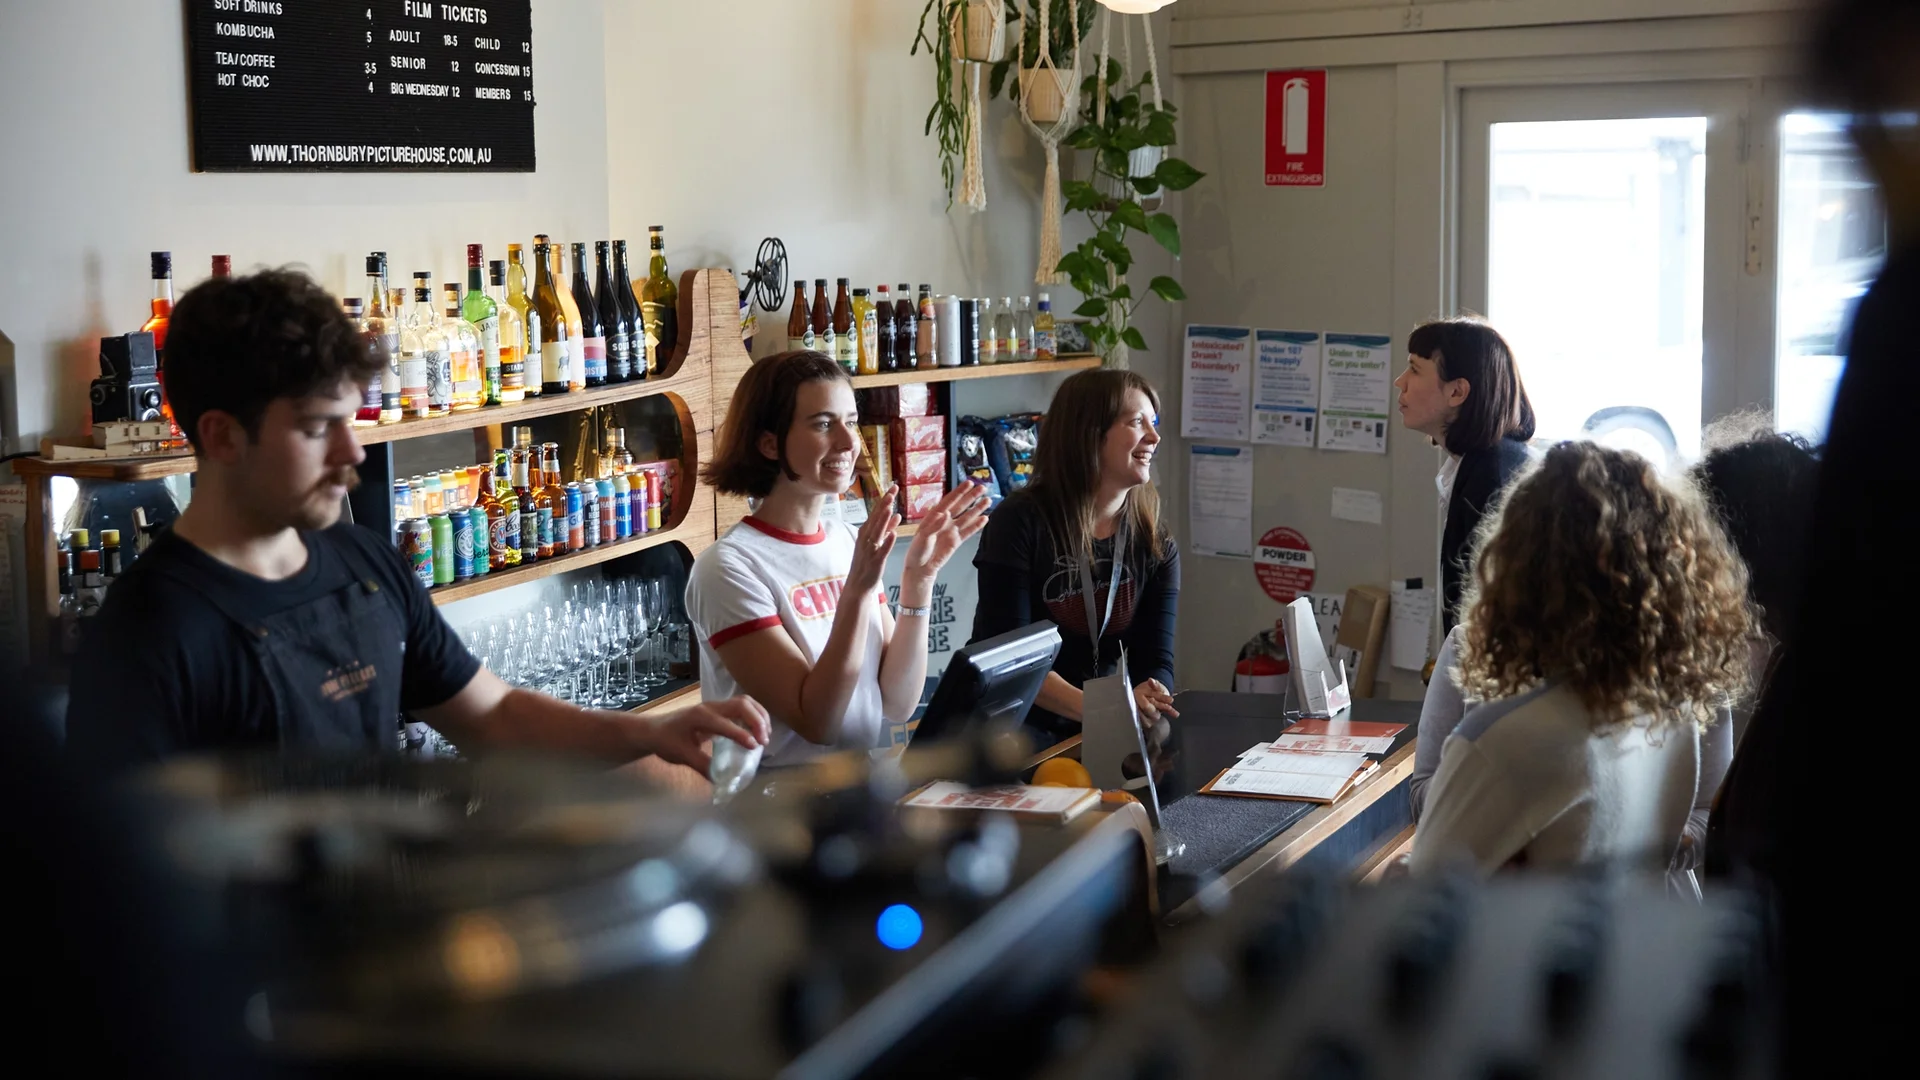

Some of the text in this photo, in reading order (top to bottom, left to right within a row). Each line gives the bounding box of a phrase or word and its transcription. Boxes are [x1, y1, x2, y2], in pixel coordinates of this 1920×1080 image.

[214, 0, 372, 20] SOFT DRINKS 4
[404, 0, 488, 24] FILM TICKETS
[216, 22, 373, 43] KOMBUCHA 5
[389, 29, 421, 43] ADULT
[474, 37, 530, 53] CHILD 12
[390, 56, 460, 72] SENIOR 12
[475, 62, 531, 77] CONCESSION 15
[217, 73, 374, 93] HOT CHOC 4
[390, 82, 460, 98] BIG WEDNESDAY 12
[475, 87, 532, 101] MEMBERS 15
[250, 144, 492, 164] WWW.THORNBURYPICTUREHOUSE.COM.AU
[1286, 161, 1304, 172] FIRE
[1266, 173, 1323, 184] EXTINGUISHER
[1191, 340, 1244, 351] Intoxicated?
[1260, 344, 1285, 353] Under
[1328, 347, 1353, 357] Under
[1191, 351, 1223, 359] Drunk?
[1260, 354, 1301, 367] No supply
[1191, 361, 1240, 373] Disorderly?
[1328, 358, 1344, 367] Can
[1344, 361, 1358, 369] you
[1262, 548, 1306, 562] POWDER
